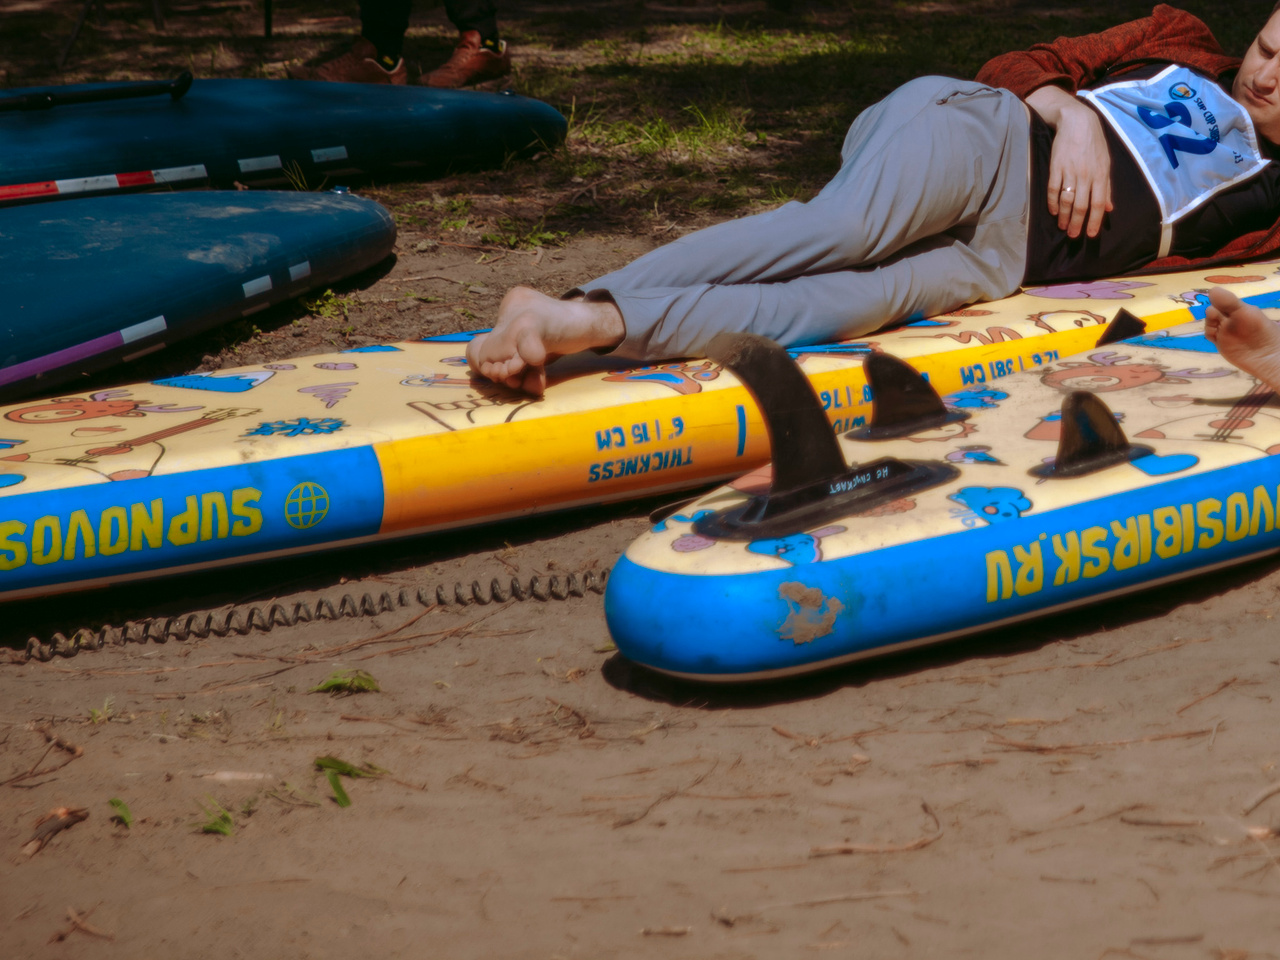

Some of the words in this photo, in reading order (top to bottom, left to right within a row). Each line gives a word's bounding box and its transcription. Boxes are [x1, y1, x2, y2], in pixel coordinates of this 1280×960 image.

[1193, 97, 1208, 111] SUP
[1203, 110, 1217, 125] CUP
[959, 363, 986, 386] CM
[988, 358, 1015, 380] 381
[820, 388, 843, 410] 76
[595, 426, 626, 452] CM
[630, 421, 650, 444] 15
[588, 446, 694, 483] THICKNESS
[0, 486, 263, 571] SUPNOVOS
